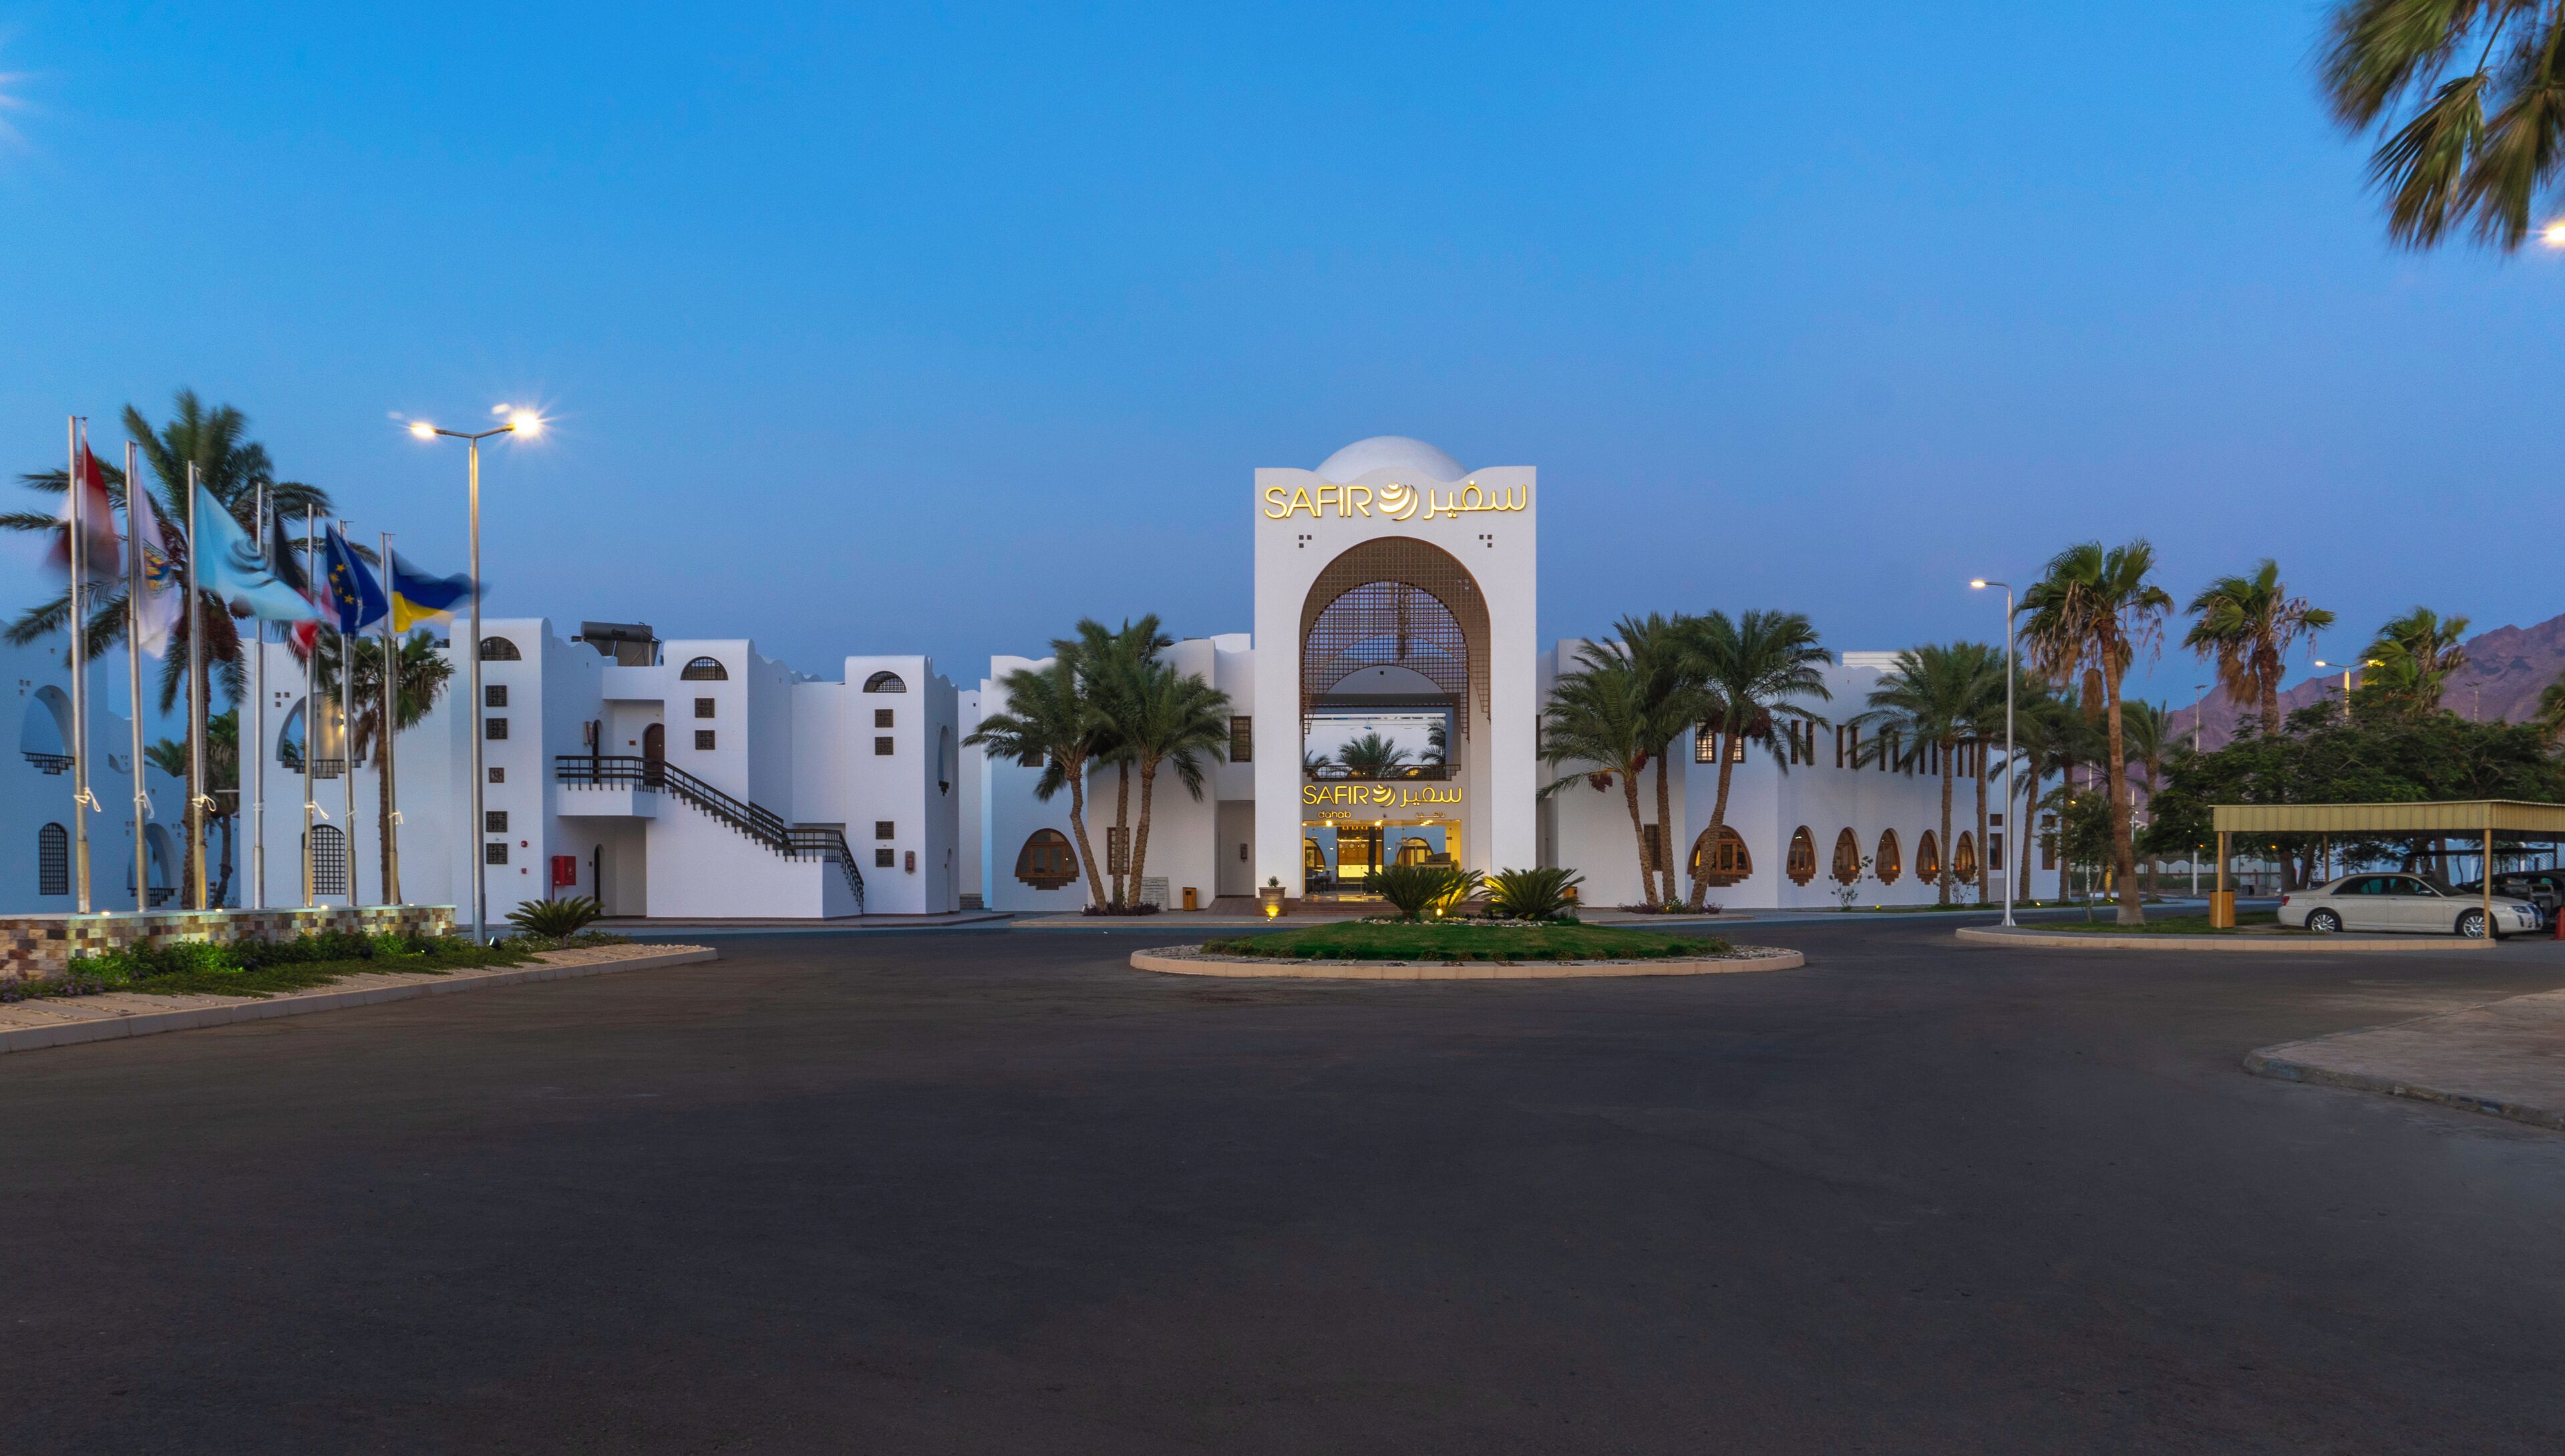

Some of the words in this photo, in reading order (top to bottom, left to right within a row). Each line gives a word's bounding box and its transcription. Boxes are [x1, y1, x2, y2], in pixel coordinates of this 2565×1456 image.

[1264, 486, 1373, 519] SAFIR
[1423, 480, 1527, 520] سفير
[1303, 785, 1369, 805] SAFIR
[1399, 783, 1462, 807] سفير
[1318, 810, 1351, 819] dahab
